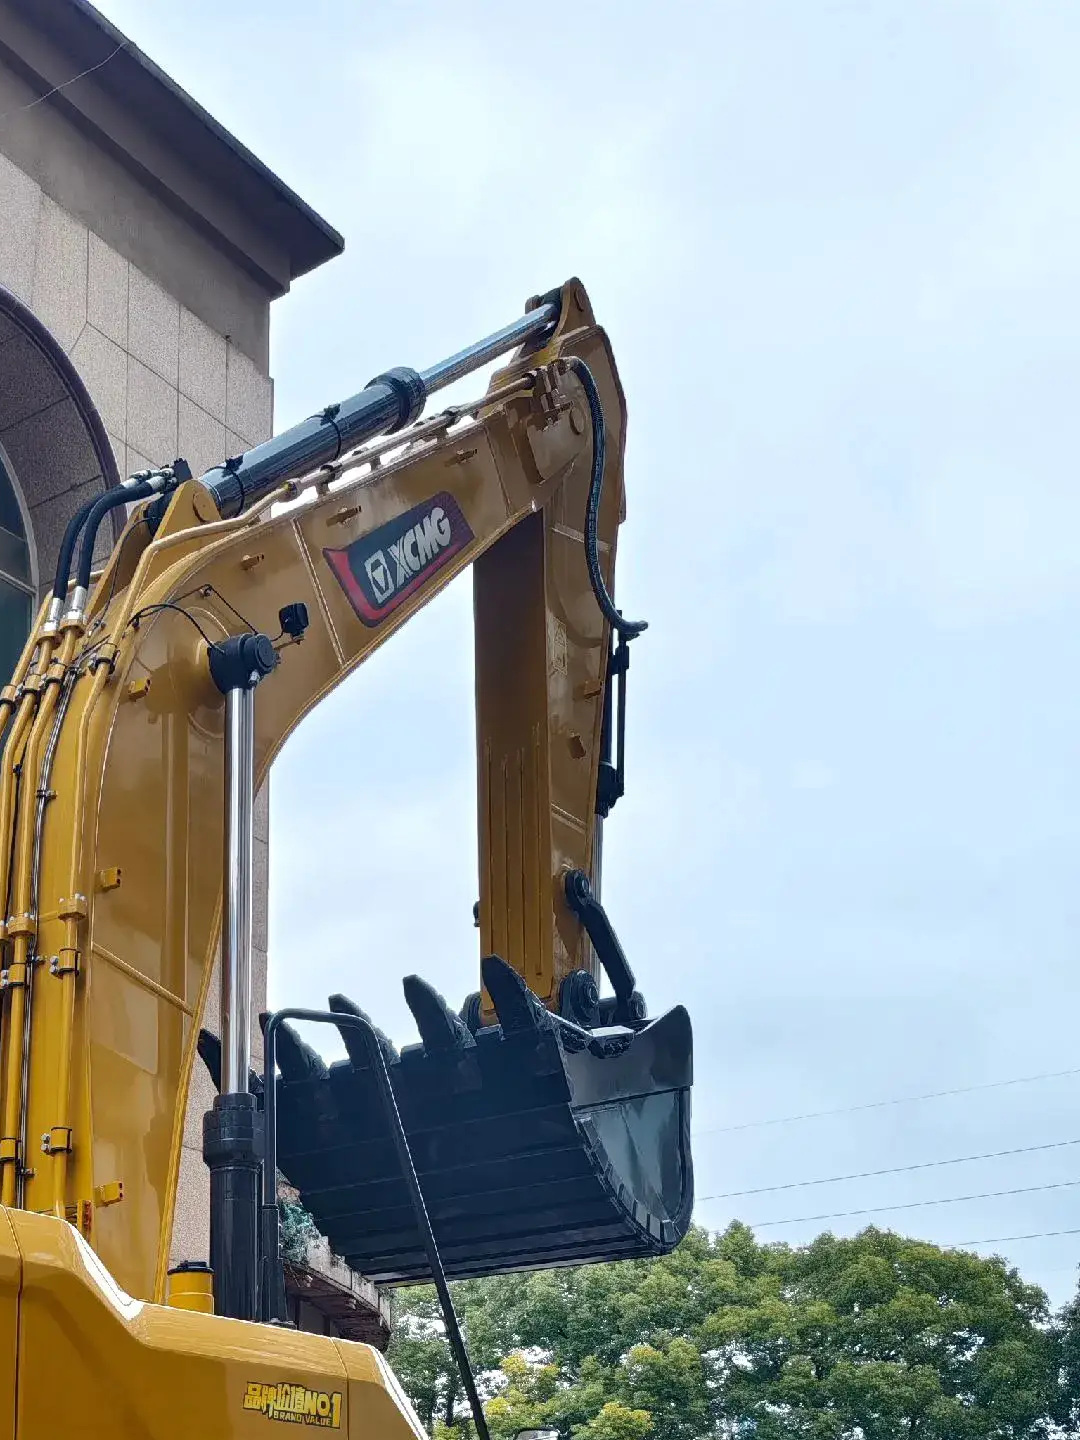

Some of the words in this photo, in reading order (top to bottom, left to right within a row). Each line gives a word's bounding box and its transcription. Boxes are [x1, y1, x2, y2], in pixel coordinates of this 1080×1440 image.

[387, 507, 451, 588] XCMG
[273, 1411, 302, 1423] BRAND
[305, 1414, 332, 1427] VALUE
